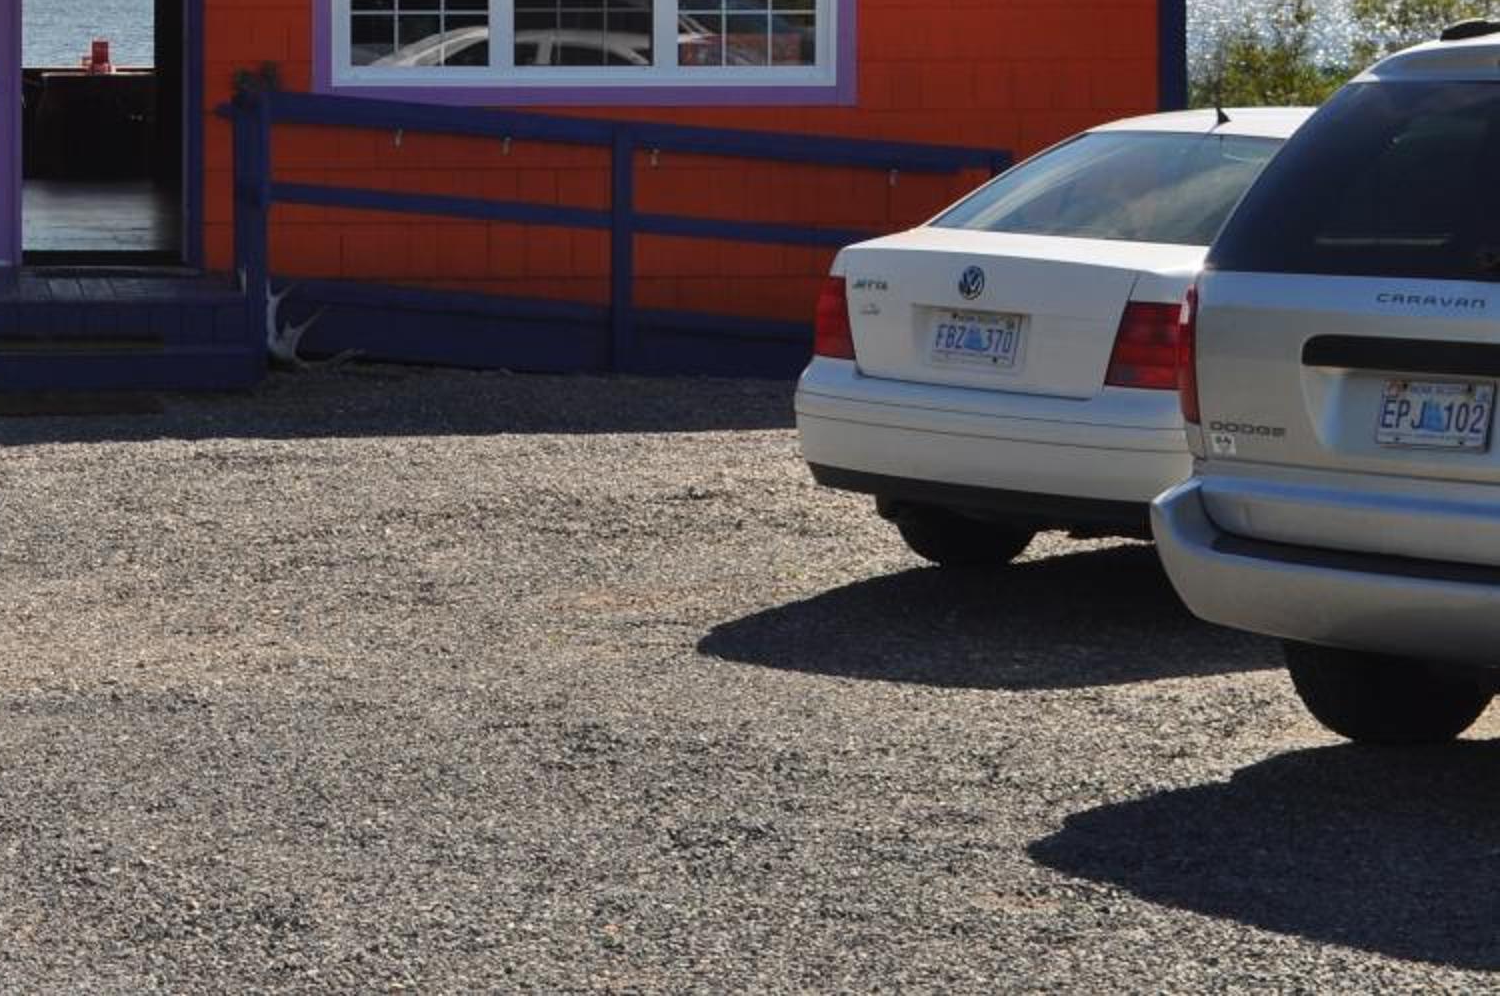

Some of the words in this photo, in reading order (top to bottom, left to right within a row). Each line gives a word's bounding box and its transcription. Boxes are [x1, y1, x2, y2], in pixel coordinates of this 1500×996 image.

[1376, 292, 1486, 309] CARAVAN
[1380, 395, 1428, 430] EPJ
[1443, 400, 1485, 434] 102
[1209, 420, 1287, 438] DODGE
